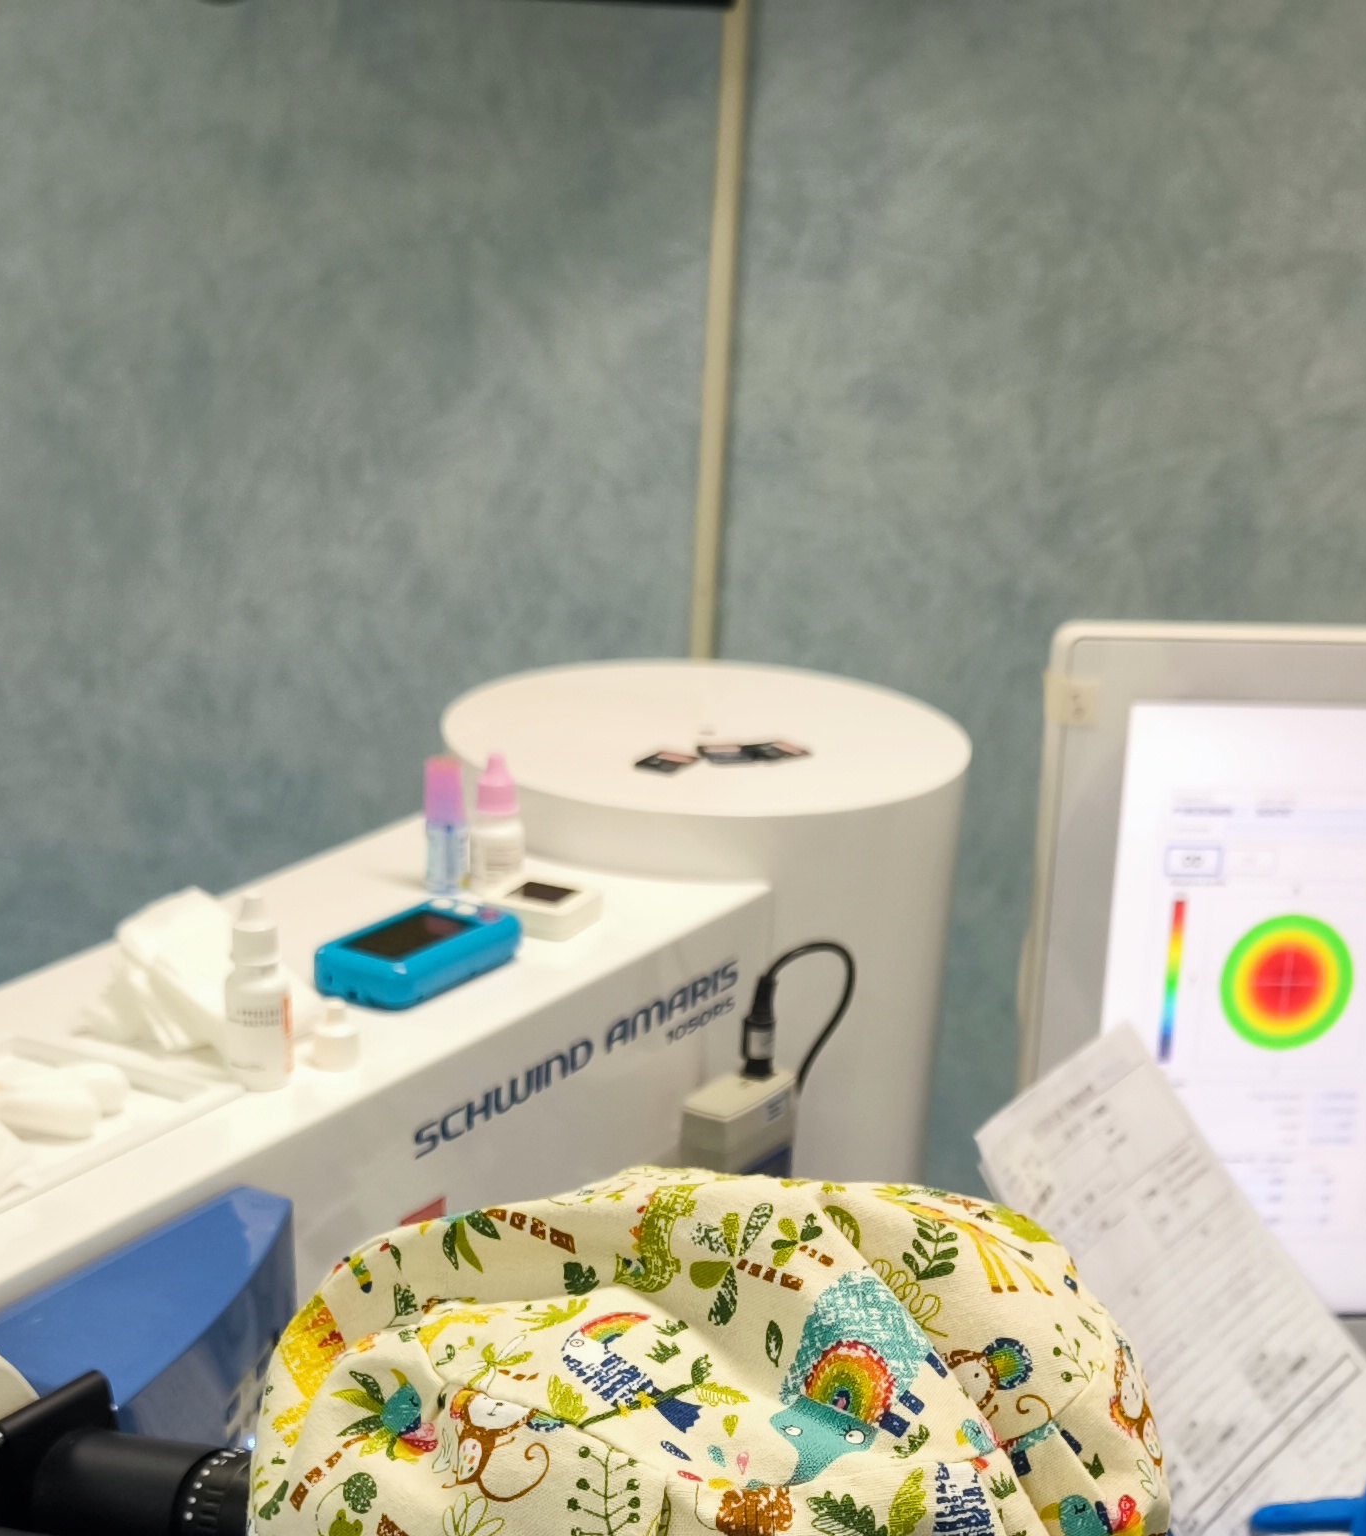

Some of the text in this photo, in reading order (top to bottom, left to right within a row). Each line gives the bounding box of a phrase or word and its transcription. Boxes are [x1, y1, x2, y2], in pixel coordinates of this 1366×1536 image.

[413, 960, 739, 1159] SCHWIND AMARIS
[666, 996, 735, 1045] 1050RS
